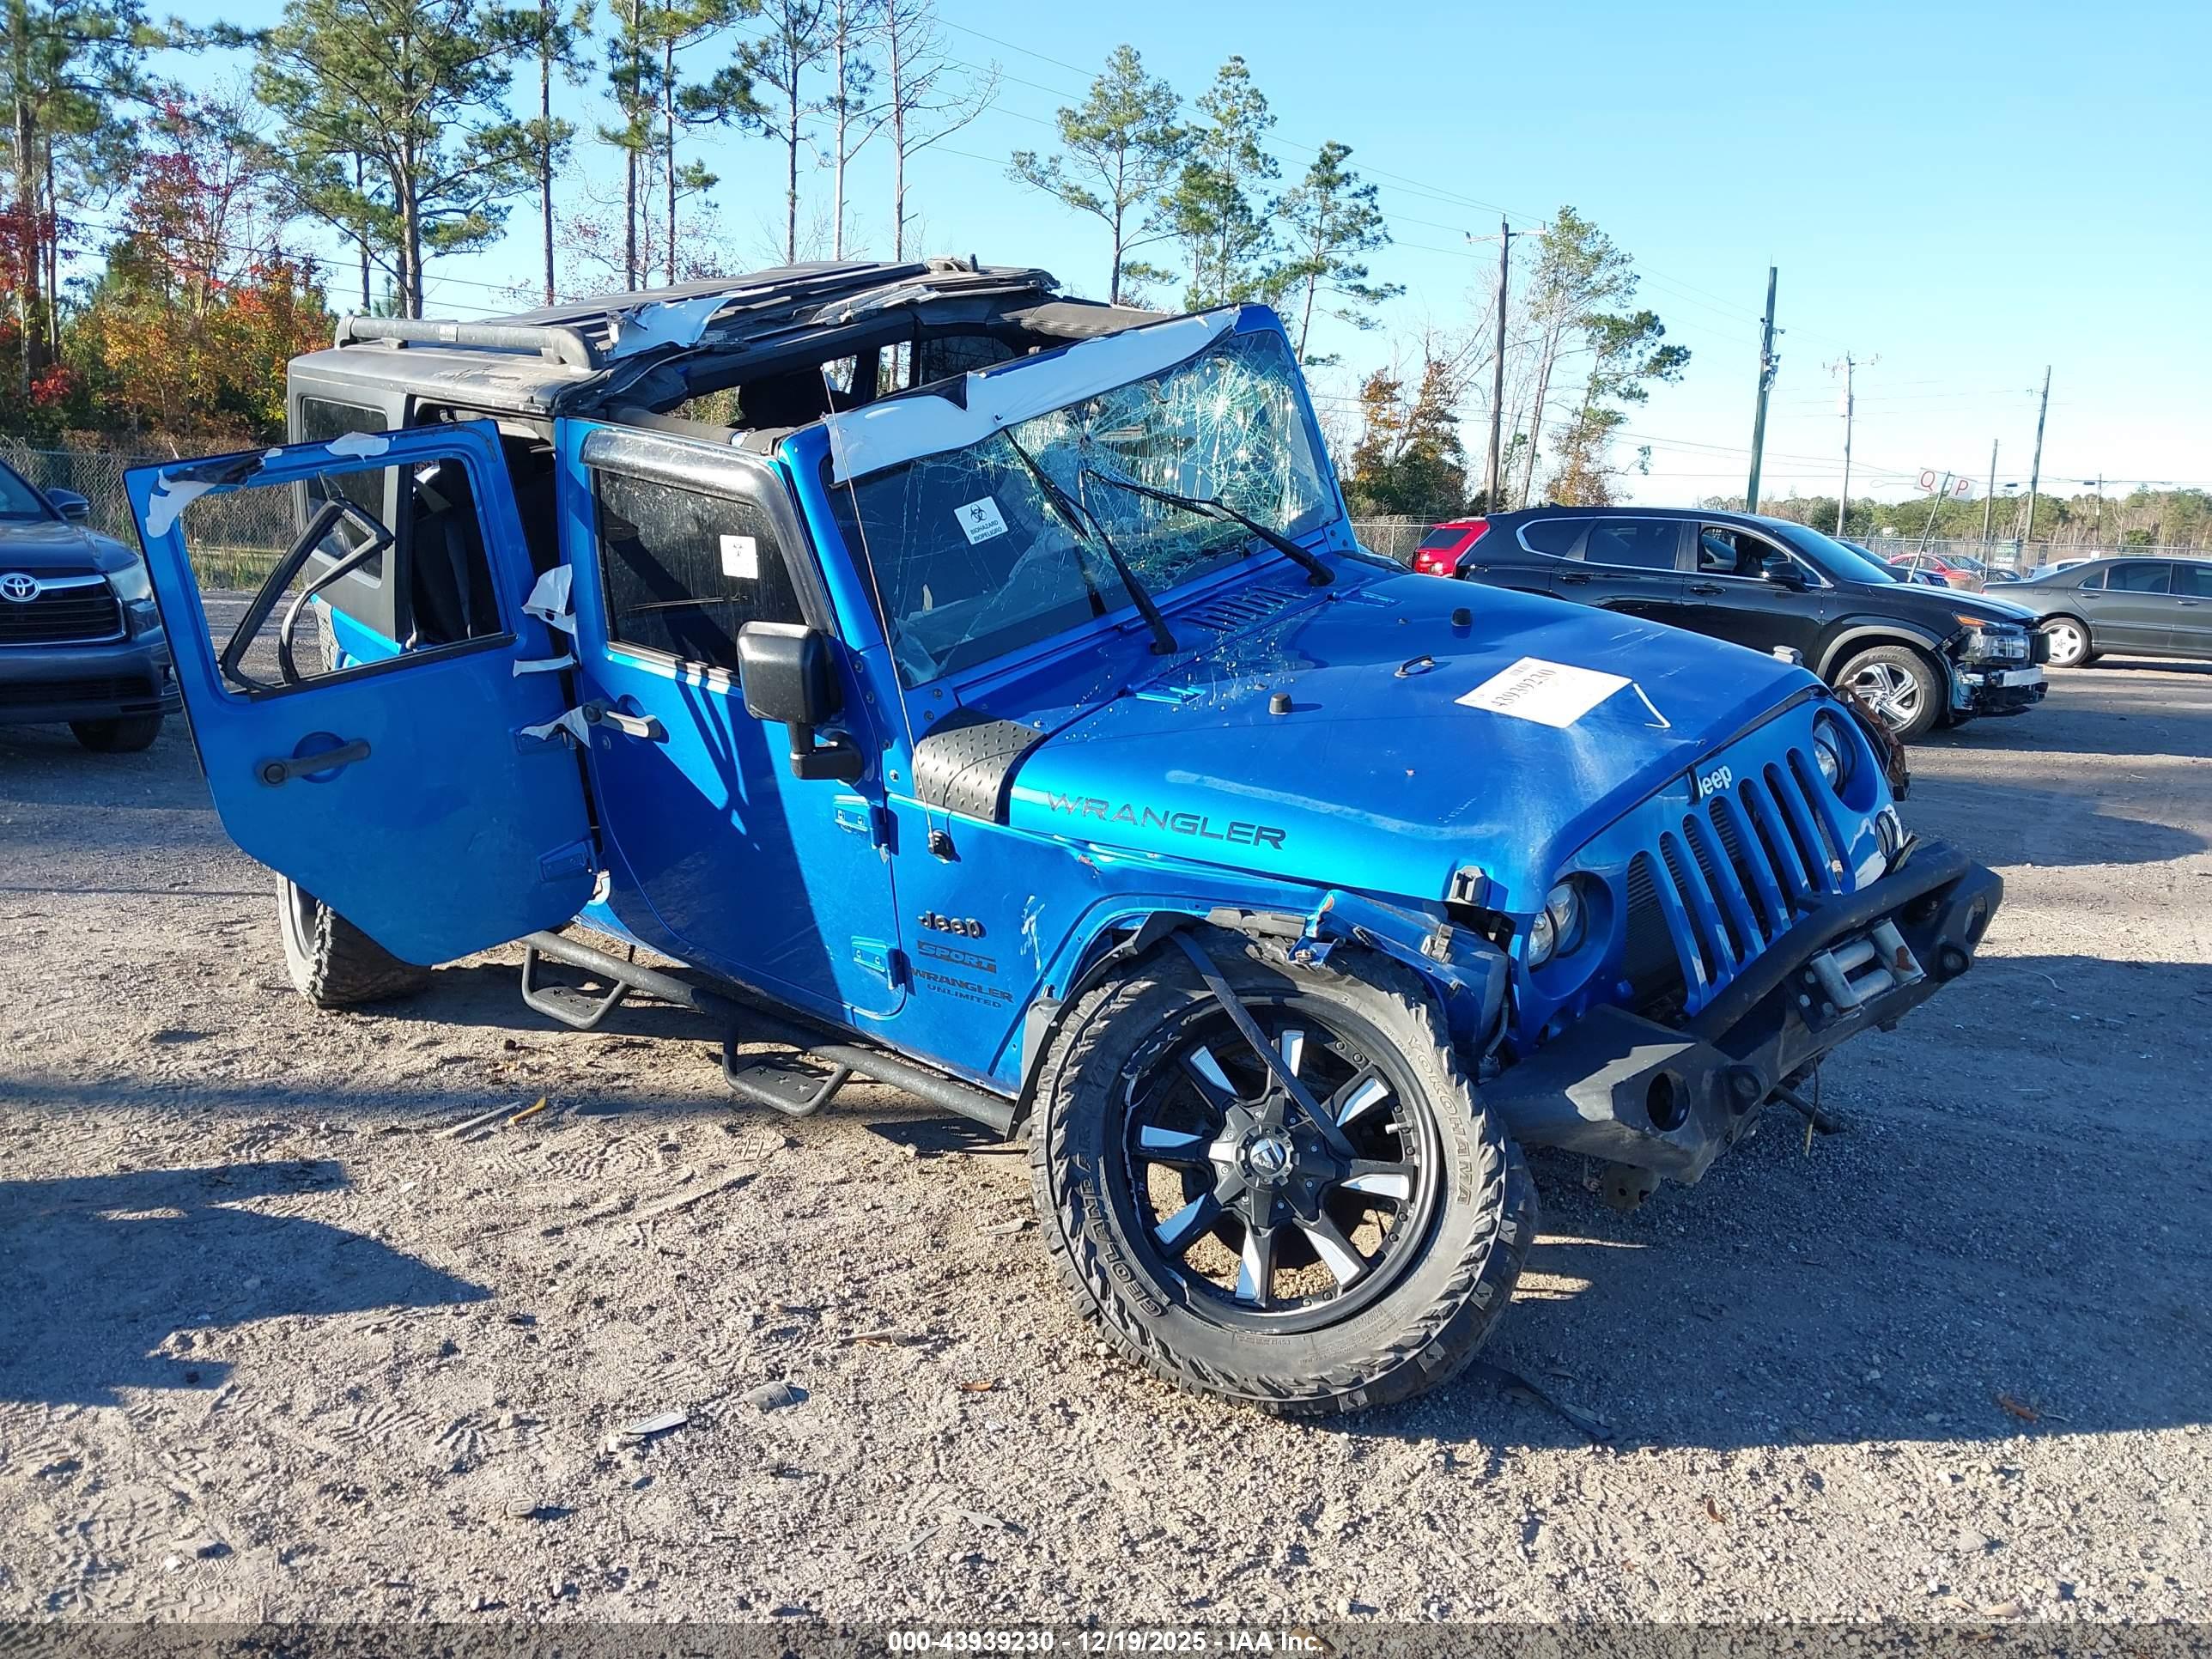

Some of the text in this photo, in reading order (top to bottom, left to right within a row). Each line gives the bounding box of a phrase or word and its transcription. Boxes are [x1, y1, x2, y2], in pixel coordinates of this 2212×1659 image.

[1920, 470, 1936, 492] Q
[1954, 479, 1969, 496] P
[969, 520, 999, 535] BIOHAZARD
[1490, 668, 1557, 707] 43939230
[1046, 790, 1287, 851] WRANGLER
[916, 909, 981, 940] Jeep
[917, 942, 996, 972] SPORT
[911, 967, 1015, 1004] WRANGLER
[927, 983, 1002, 1009] UNLIMITED
[1407, 1034, 1474, 1206] YOKOHAMA
